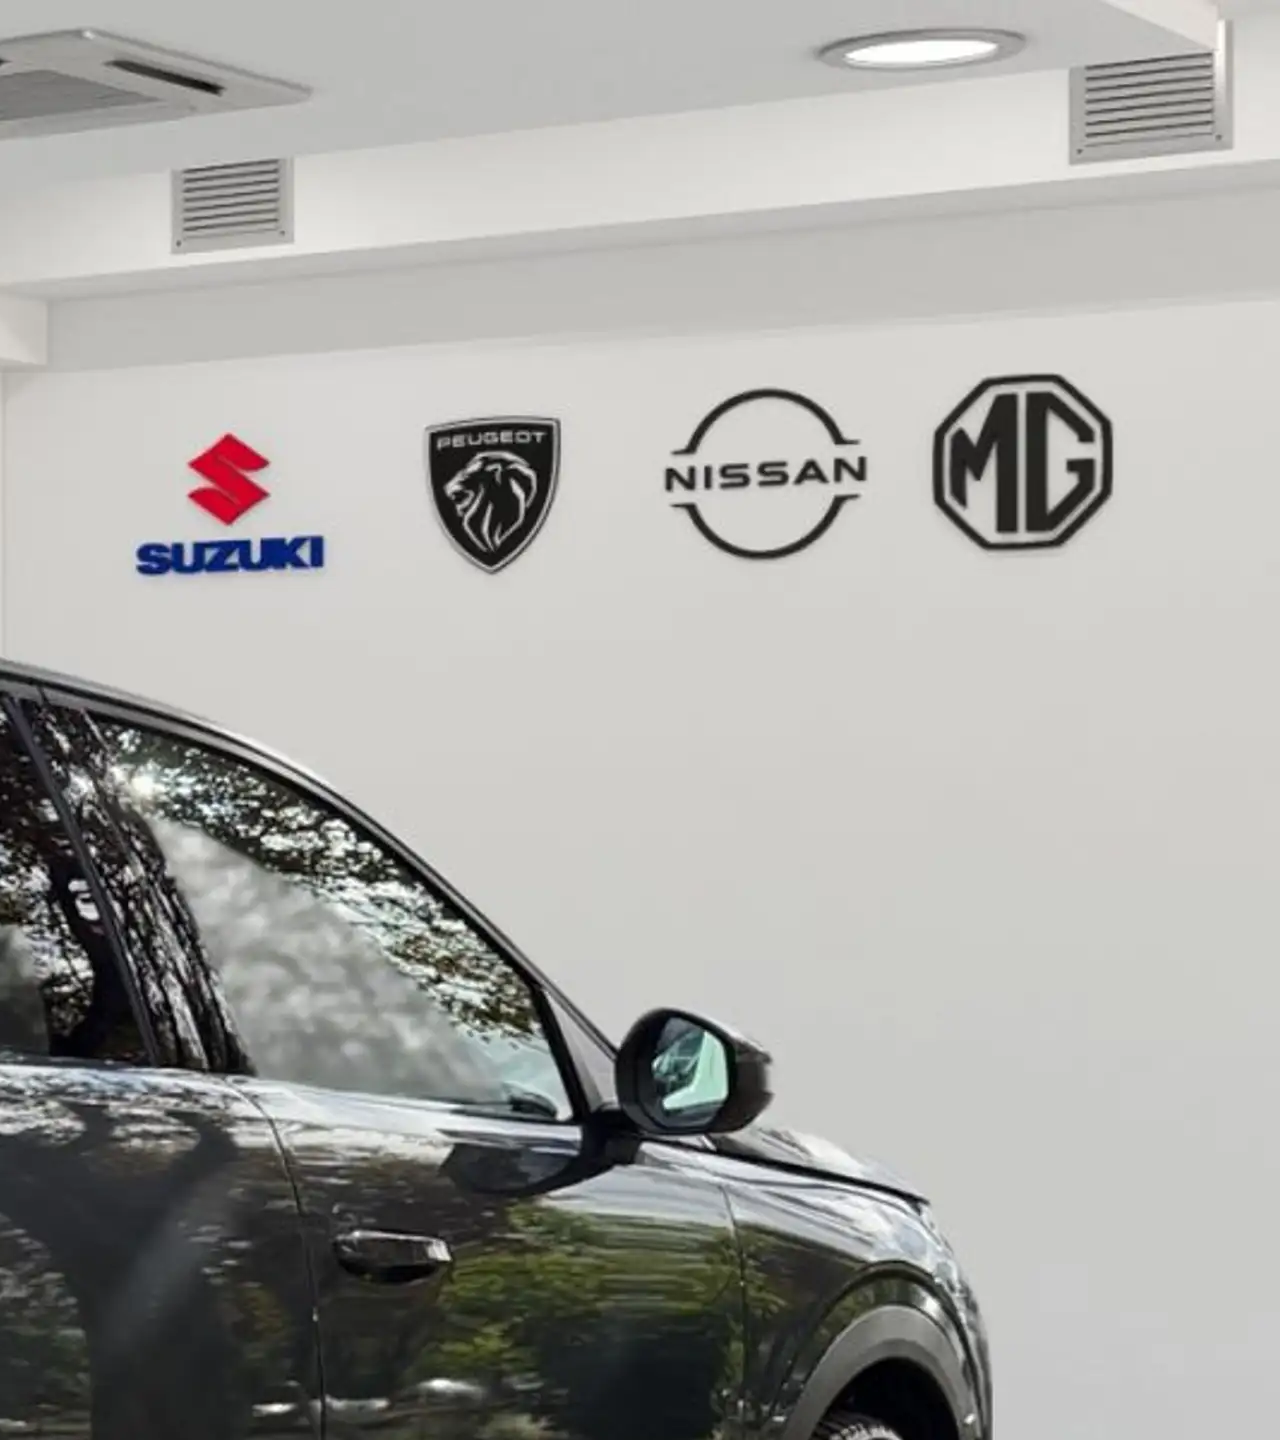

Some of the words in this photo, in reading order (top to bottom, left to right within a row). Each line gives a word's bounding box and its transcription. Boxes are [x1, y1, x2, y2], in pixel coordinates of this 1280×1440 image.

[436, 429, 547, 450] PEUGEOT
[664, 455, 868, 494] NISSAN
[950, 391, 1096, 533] MG
[136, 535, 325, 576] SUZUKI
